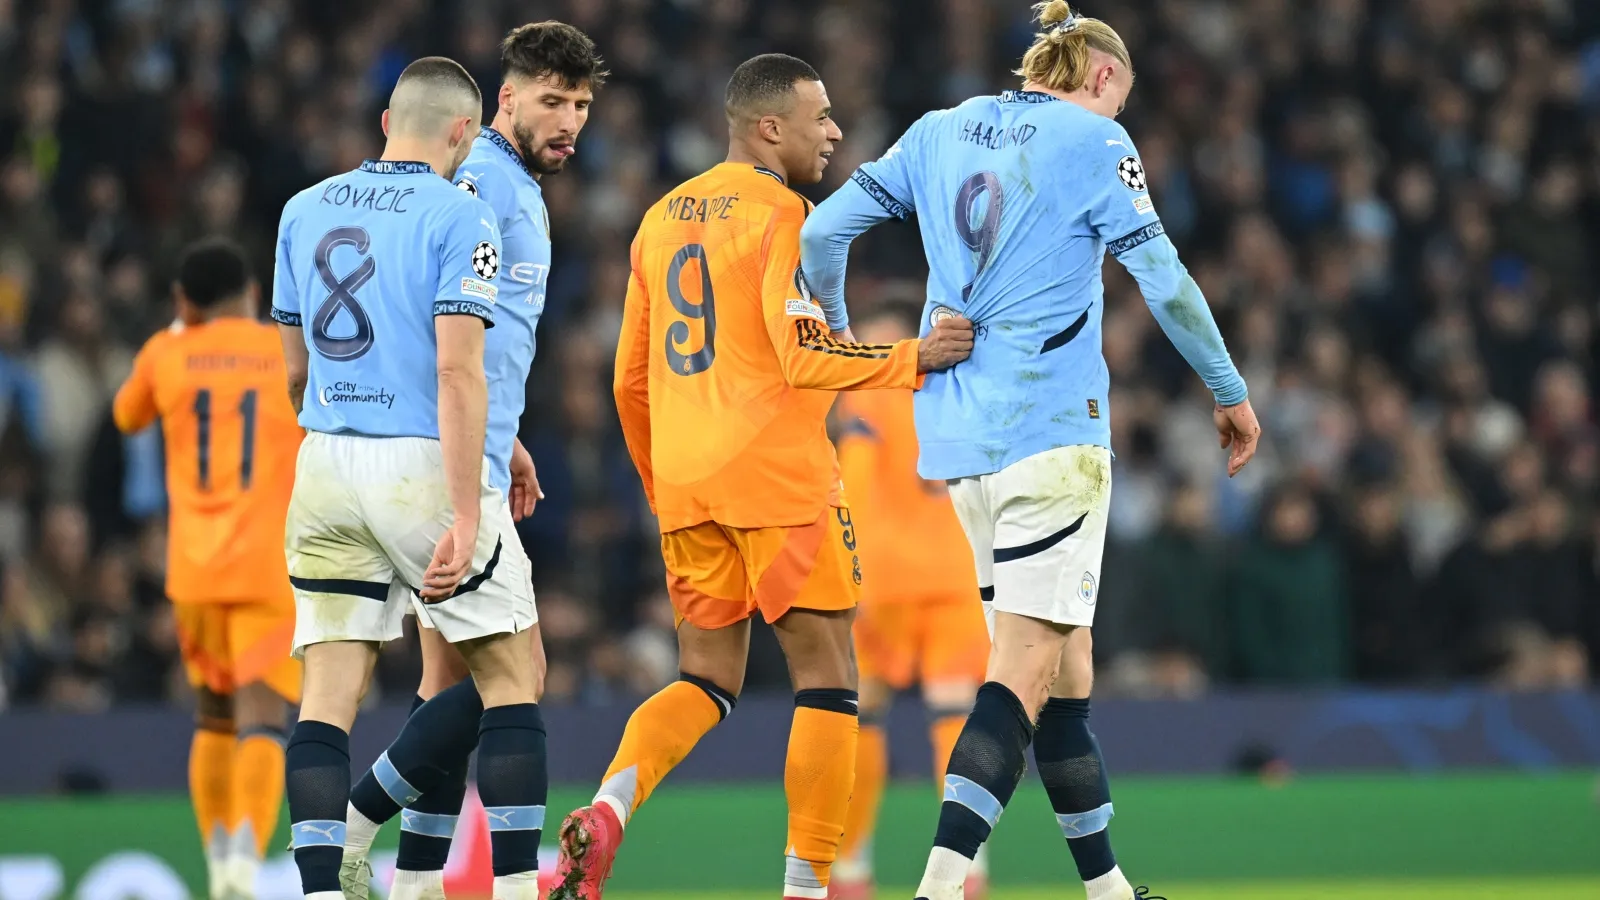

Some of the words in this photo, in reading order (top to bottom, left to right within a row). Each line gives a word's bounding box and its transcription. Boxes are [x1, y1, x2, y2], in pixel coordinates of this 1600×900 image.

[319, 182, 415, 213] KOVAČIĆ
[663, 192, 740, 223] MBAPPÉ
[953, 170, 1004, 303] 9
[310, 225, 376, 362] 8
[665, 243, 717, 377] 9
[324, 386, 395, 409] Community
[334, 381, 357, 393] City
[193, 388, 257, 490] 11
